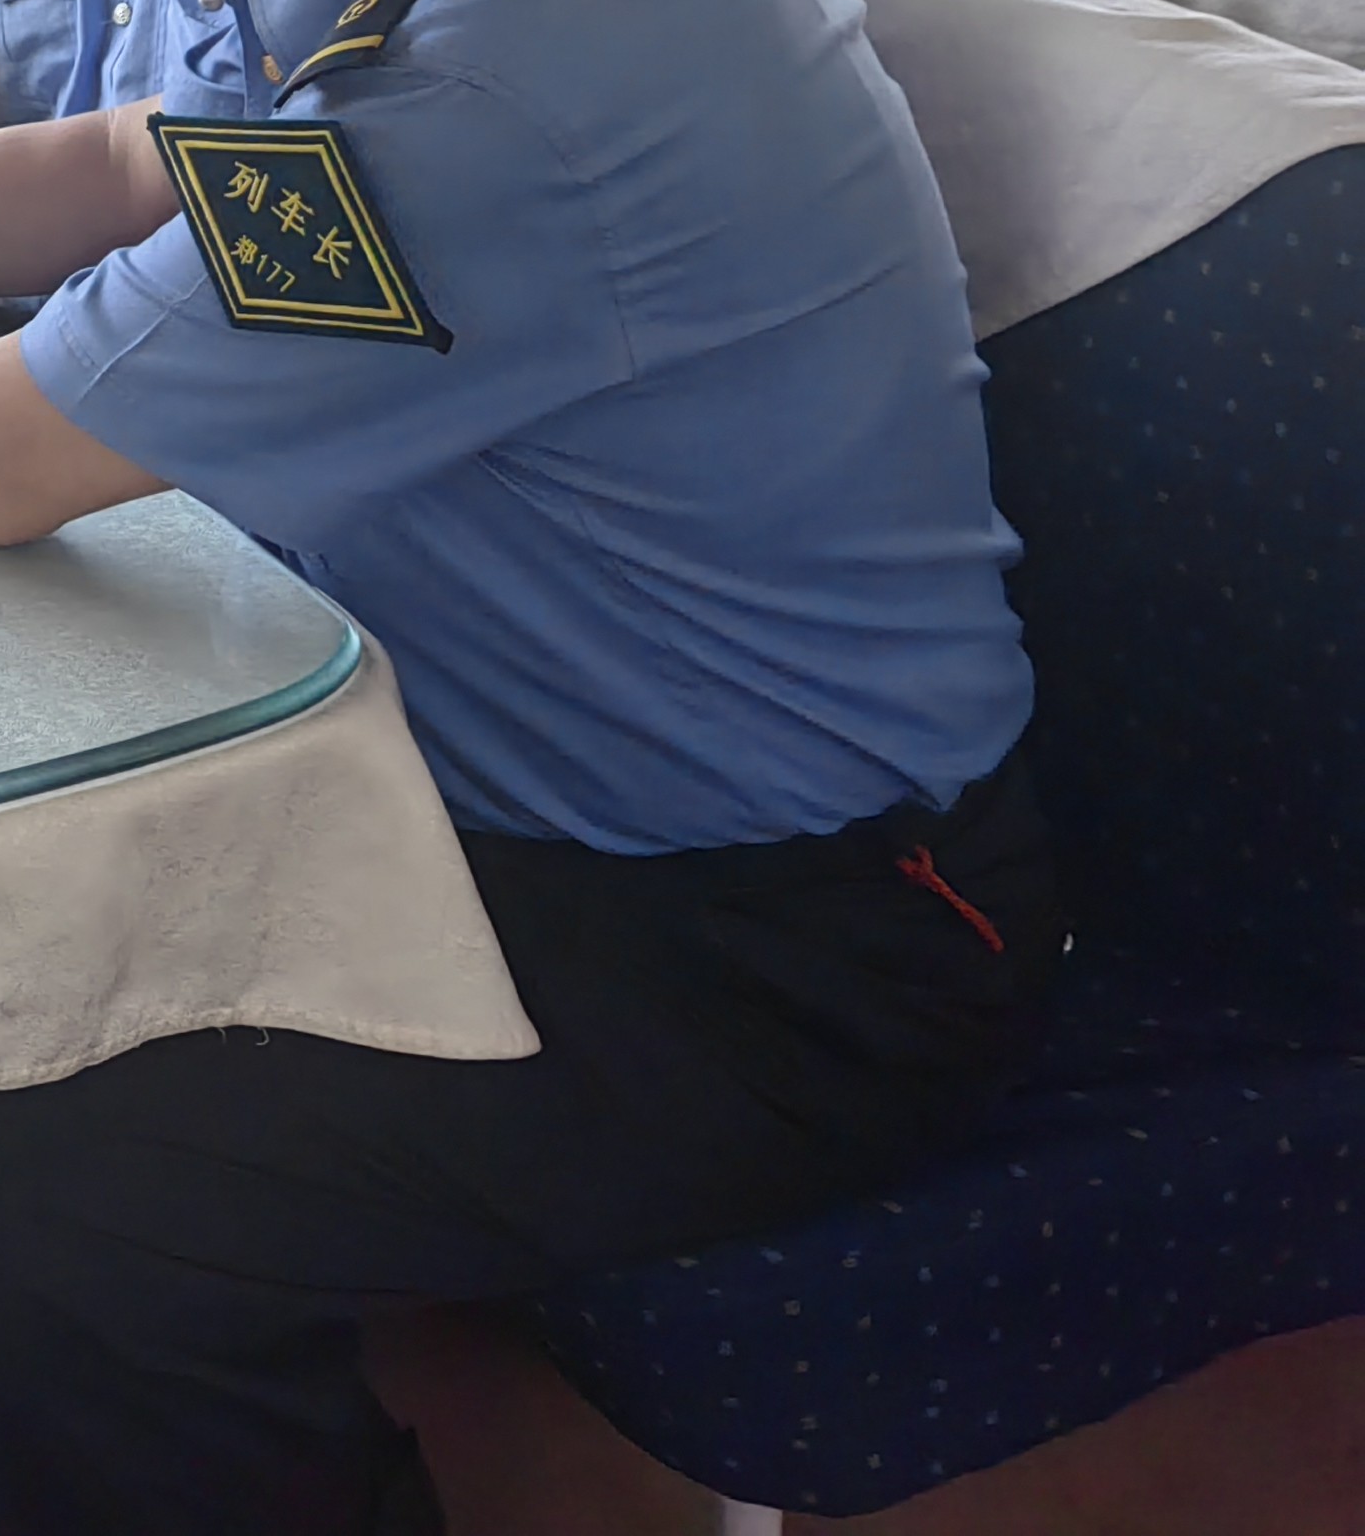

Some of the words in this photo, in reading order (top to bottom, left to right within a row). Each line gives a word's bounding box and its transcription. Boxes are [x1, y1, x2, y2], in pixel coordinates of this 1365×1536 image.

[224, 161, 353, 280] 列车长
[230, 235, 296, 292] 郑177
